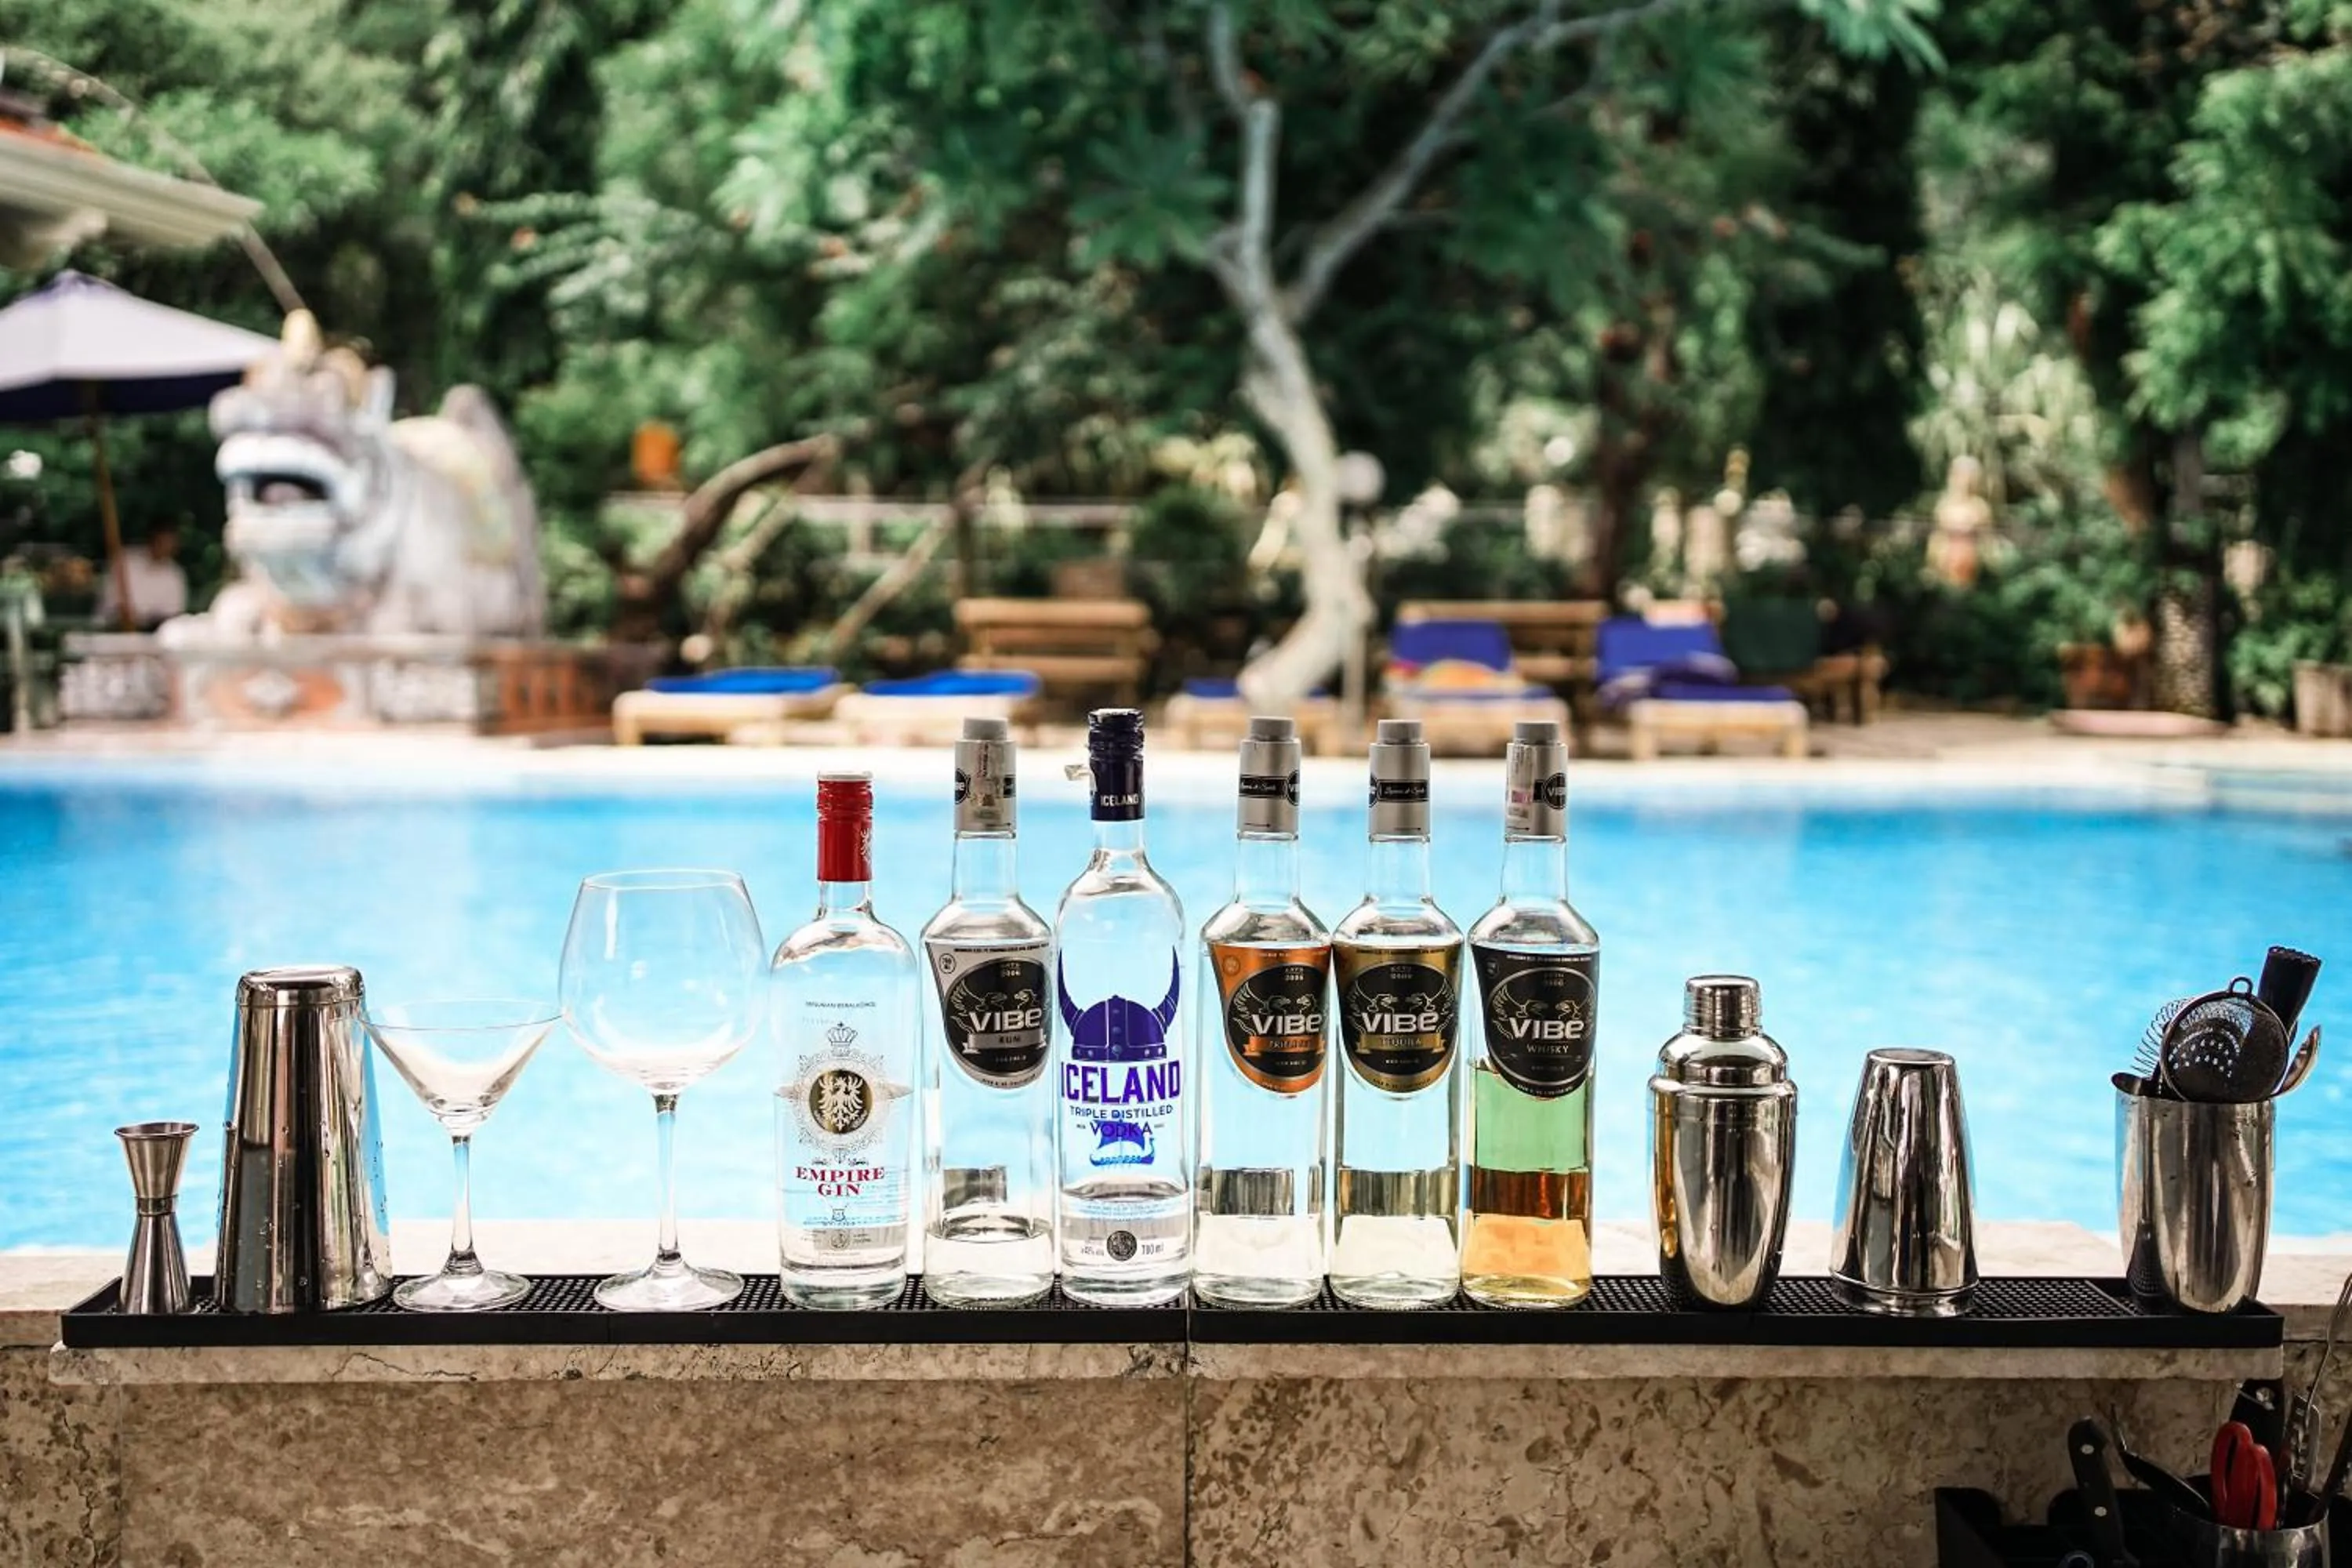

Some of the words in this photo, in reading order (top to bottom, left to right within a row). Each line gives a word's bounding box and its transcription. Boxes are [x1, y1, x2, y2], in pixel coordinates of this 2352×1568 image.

[1100, 793, 1139, 807] ICELAND
[969, 1007, 1043, 1033] VIBE
[1251, 1014, 1323, 1036] VIBE
[1361, 1011, 1439, 1033] VIBE
[1508, 1017, 1585, 1040] VIBE
[1061, 1059, 1181, 1105] ICELAND
[1069, 1105, 1108, 1119] TRIPLE
[1111, 1104, 1174, 1119] DISTILLED
[1090, 1120, 1153, 1137] VODKA
[795, 1166, 885, 1183] EMPIRE
[818, 1183, 862, 1196] GIN
